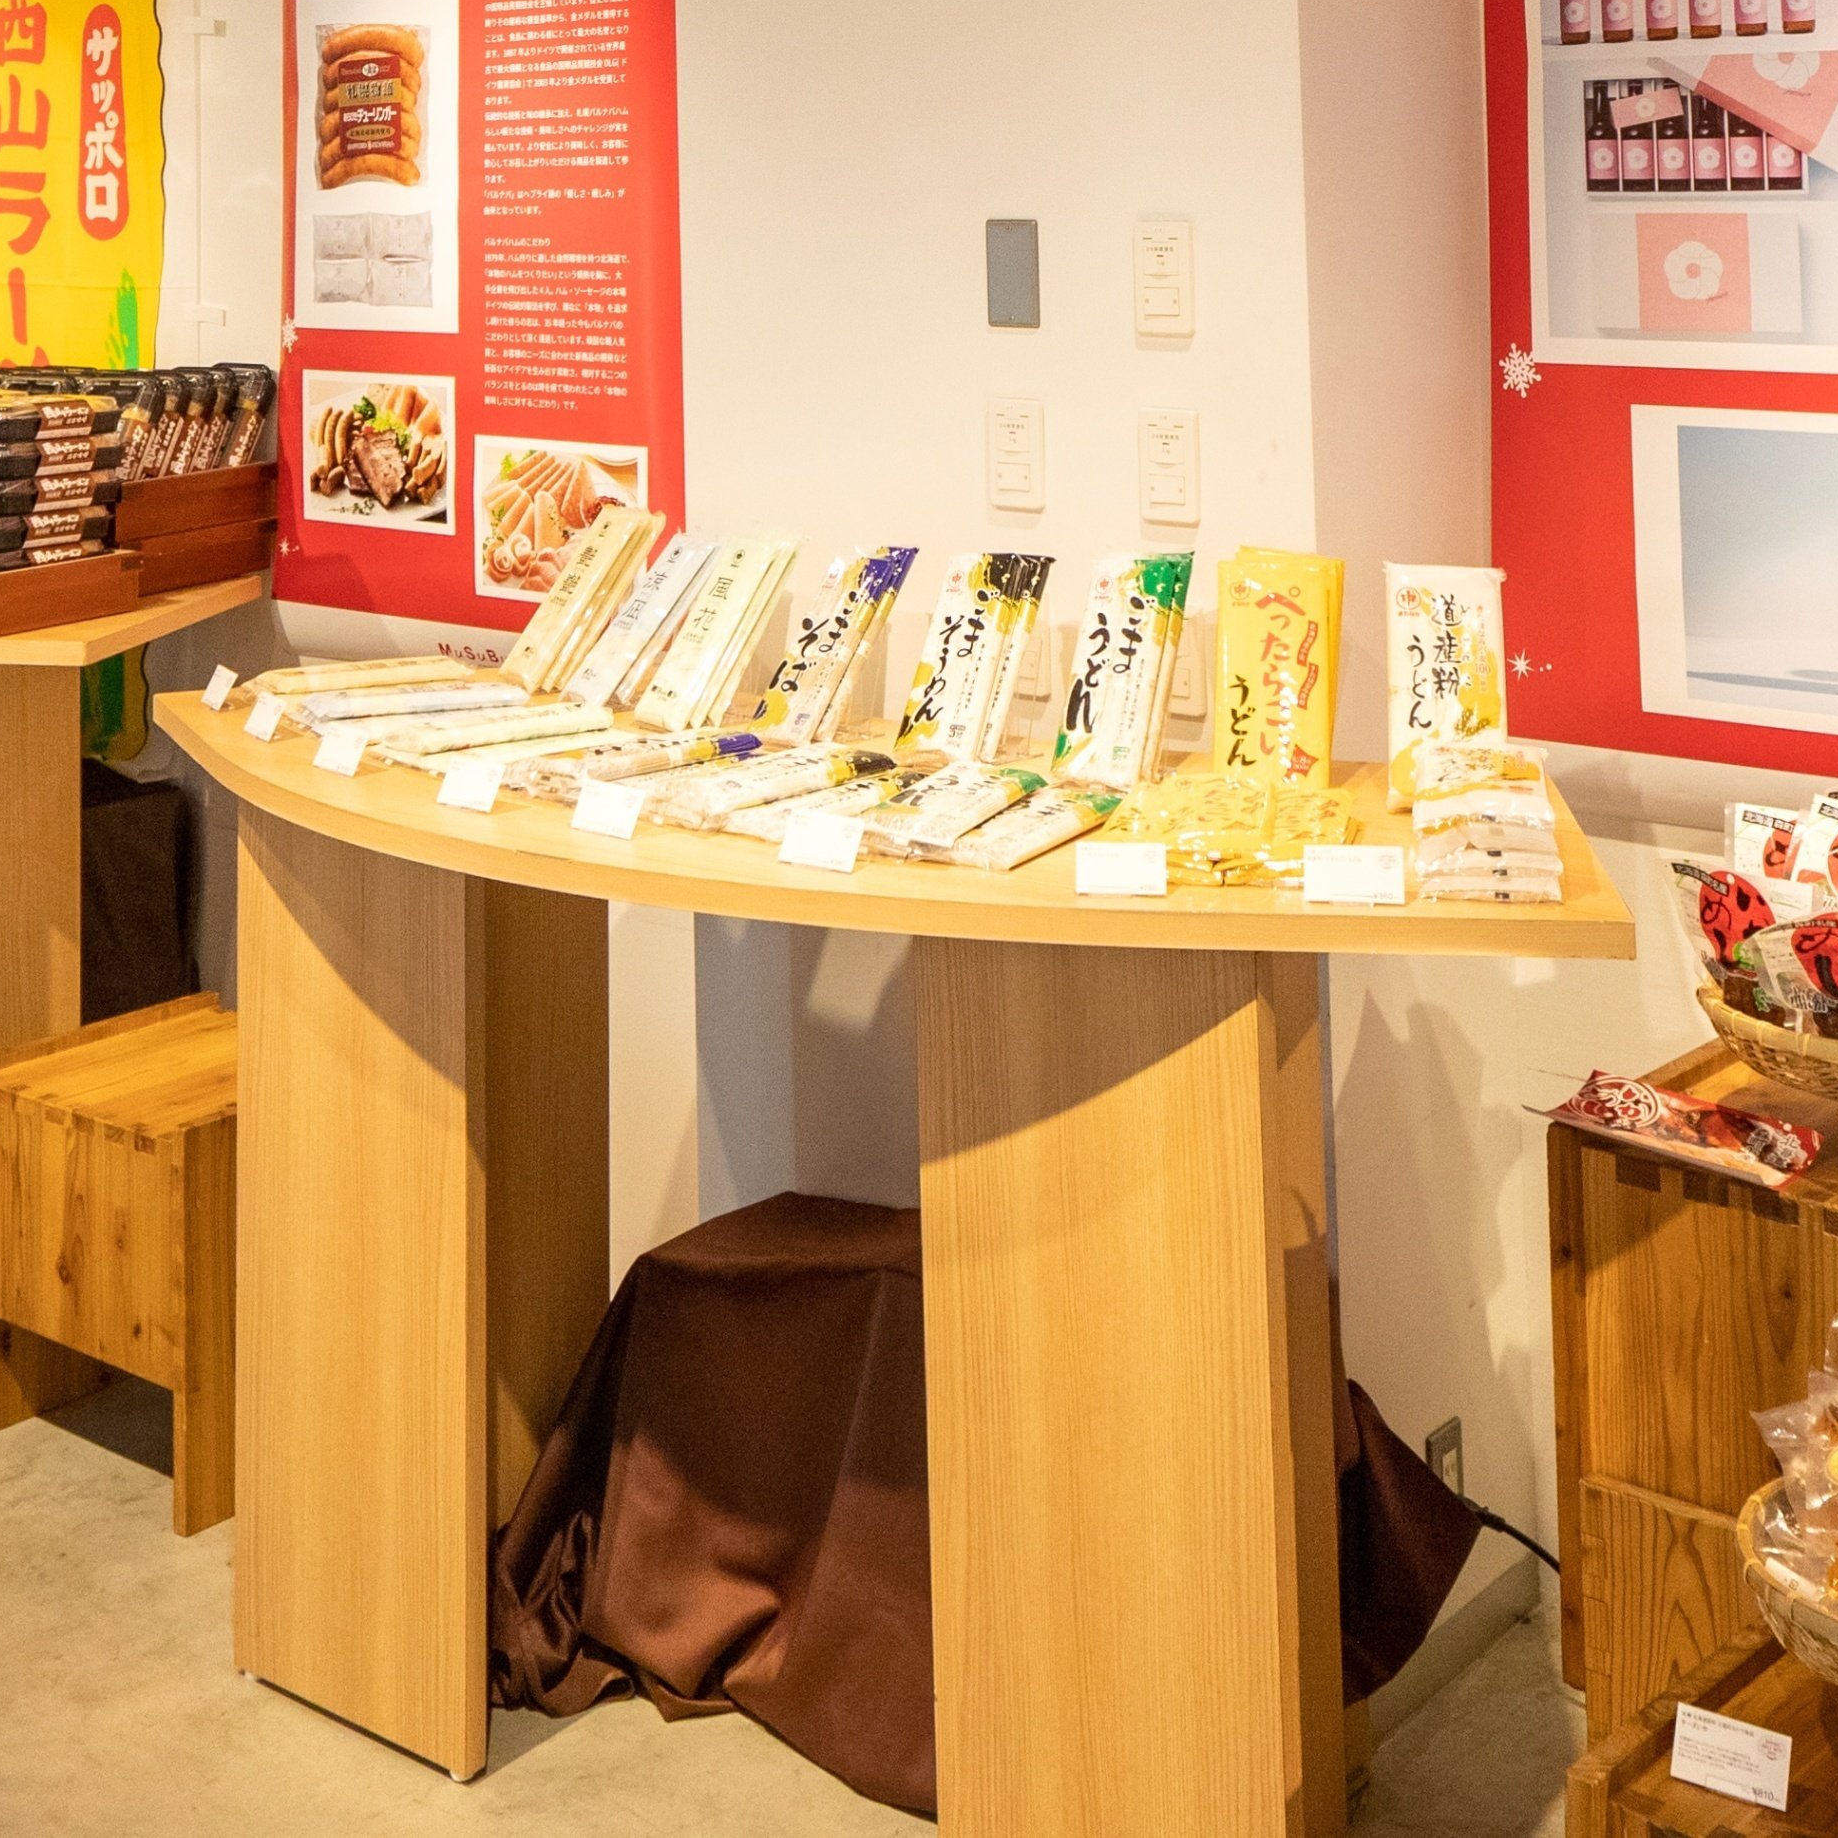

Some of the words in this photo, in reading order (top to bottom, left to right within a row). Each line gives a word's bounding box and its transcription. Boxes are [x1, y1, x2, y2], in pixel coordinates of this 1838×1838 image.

[83, 26, 124, 222] サッポロ
[914, 614, 964, 723] そうめん
[1066, 612, 1111, 733] うどん
[1407, 634, 1432, 729] うどん
[1432, 594, 1462, 698] 道産粉
[1227, 673, 1257, 766] うどん
